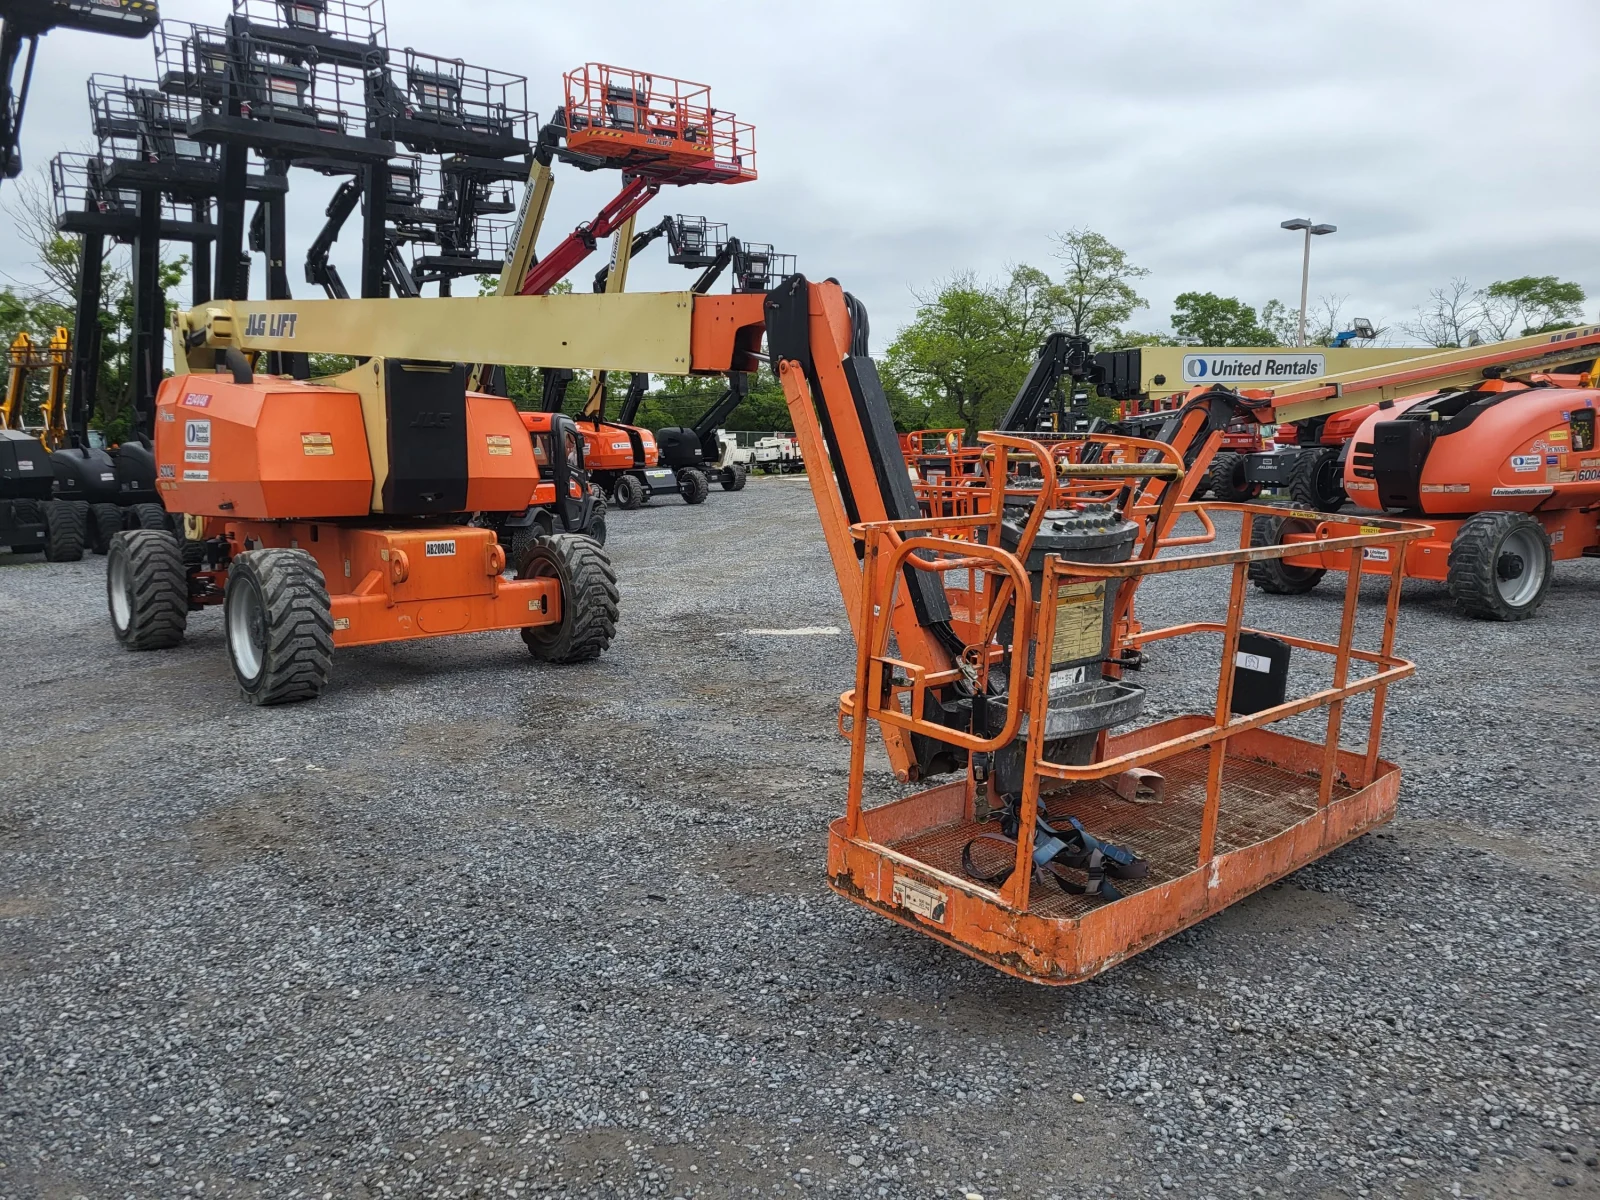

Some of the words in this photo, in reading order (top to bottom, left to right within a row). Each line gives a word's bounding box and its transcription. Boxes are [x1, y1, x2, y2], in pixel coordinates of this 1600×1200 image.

[511, 218, 523, 252] United
[521, 183, 534, 217] Rentals
[244, 312, 267, 337] JLG
[268, 313, 298, 339] LIFT
[1211, 359, 1262, 377] United
[1265, 359, 1318, 376] Rentals
[195, 424, 209, 433] United
[195, 434, 209, 443] Rentals
[1493, 488, 1552, 496] UnitedRentals.com
[426, 542, 455, 555] AB208042
